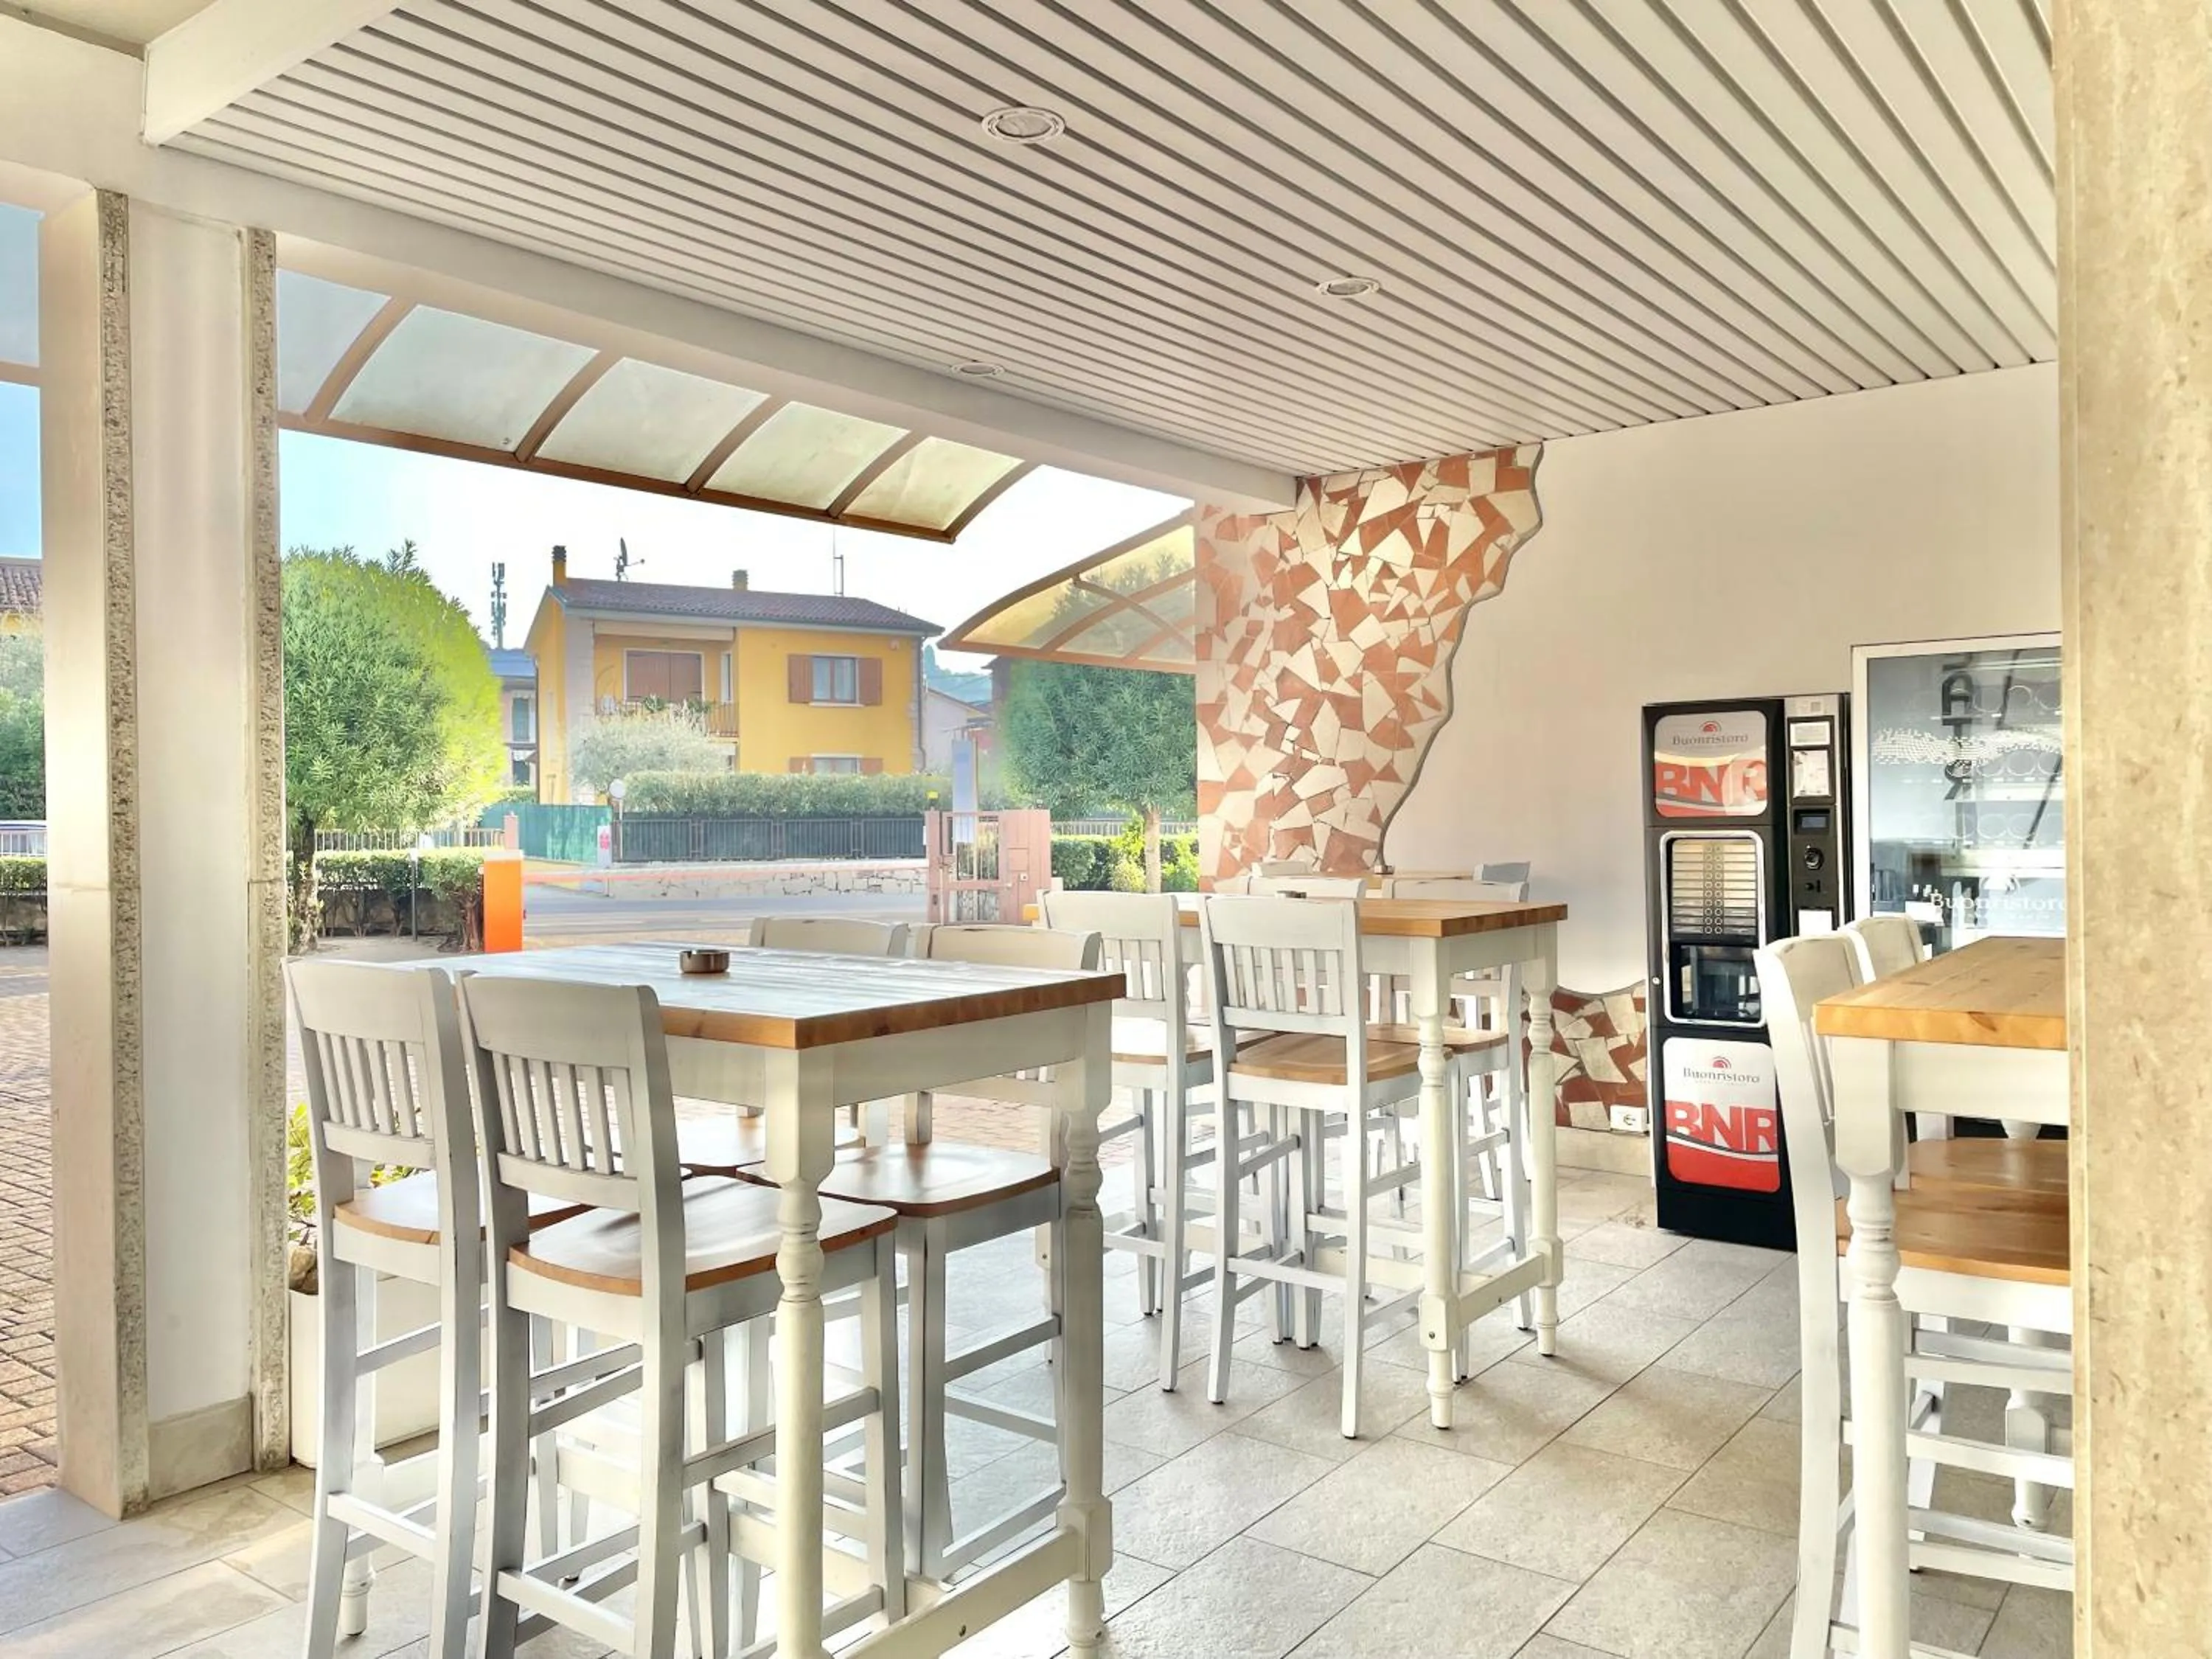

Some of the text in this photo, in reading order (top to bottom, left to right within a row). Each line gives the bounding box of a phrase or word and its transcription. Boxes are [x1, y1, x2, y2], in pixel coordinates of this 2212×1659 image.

[1672, 734, 1749, 746] Buonristoro
[1683, 1067, 1761, 1084] Buonristoro
[1665, 1099, 1777, 1153] BNR
